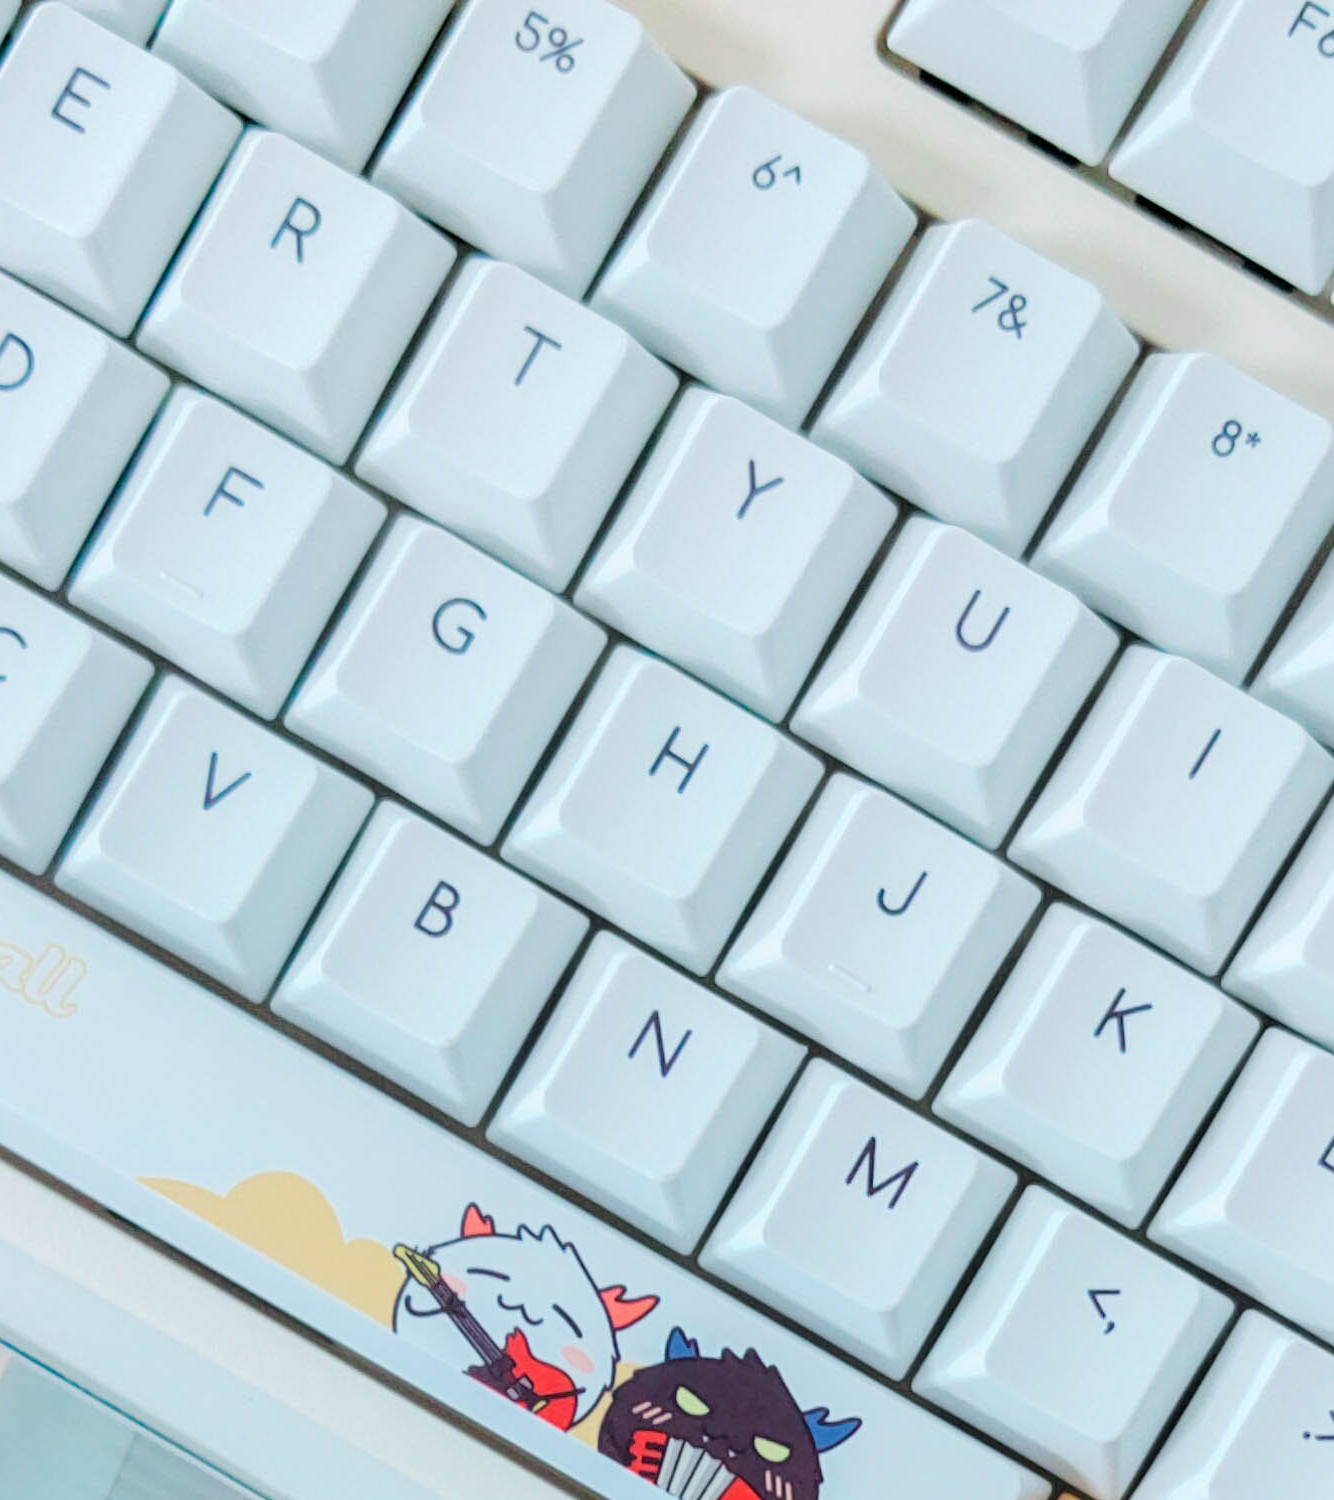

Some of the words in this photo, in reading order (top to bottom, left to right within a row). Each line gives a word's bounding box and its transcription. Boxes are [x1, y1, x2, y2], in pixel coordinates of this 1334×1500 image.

[514, 10, 584, 74] 5%
[50, 66, 111, 134] E
[270, 196, 322, 263] R
[971, 276, 1028, 340] 7&
[514, 325, 563, 387] T
[203, 465, 265, 517] F
[737, 459, 784, 520] Y
[431, 597, 488, 655] G
[955, 589, 1011, 653] U
[202, 751, 252, 811] V
[648, 726, 710, 794] H
[1188, 728, 1222, 780] I
[413, 880, 461, 939] B
[876, 871, 928, 917] J
[627, 1009, 693, 1078] N
[1093, 987, 1153, 1054] K
[845, 1136, 920, 1210] M
